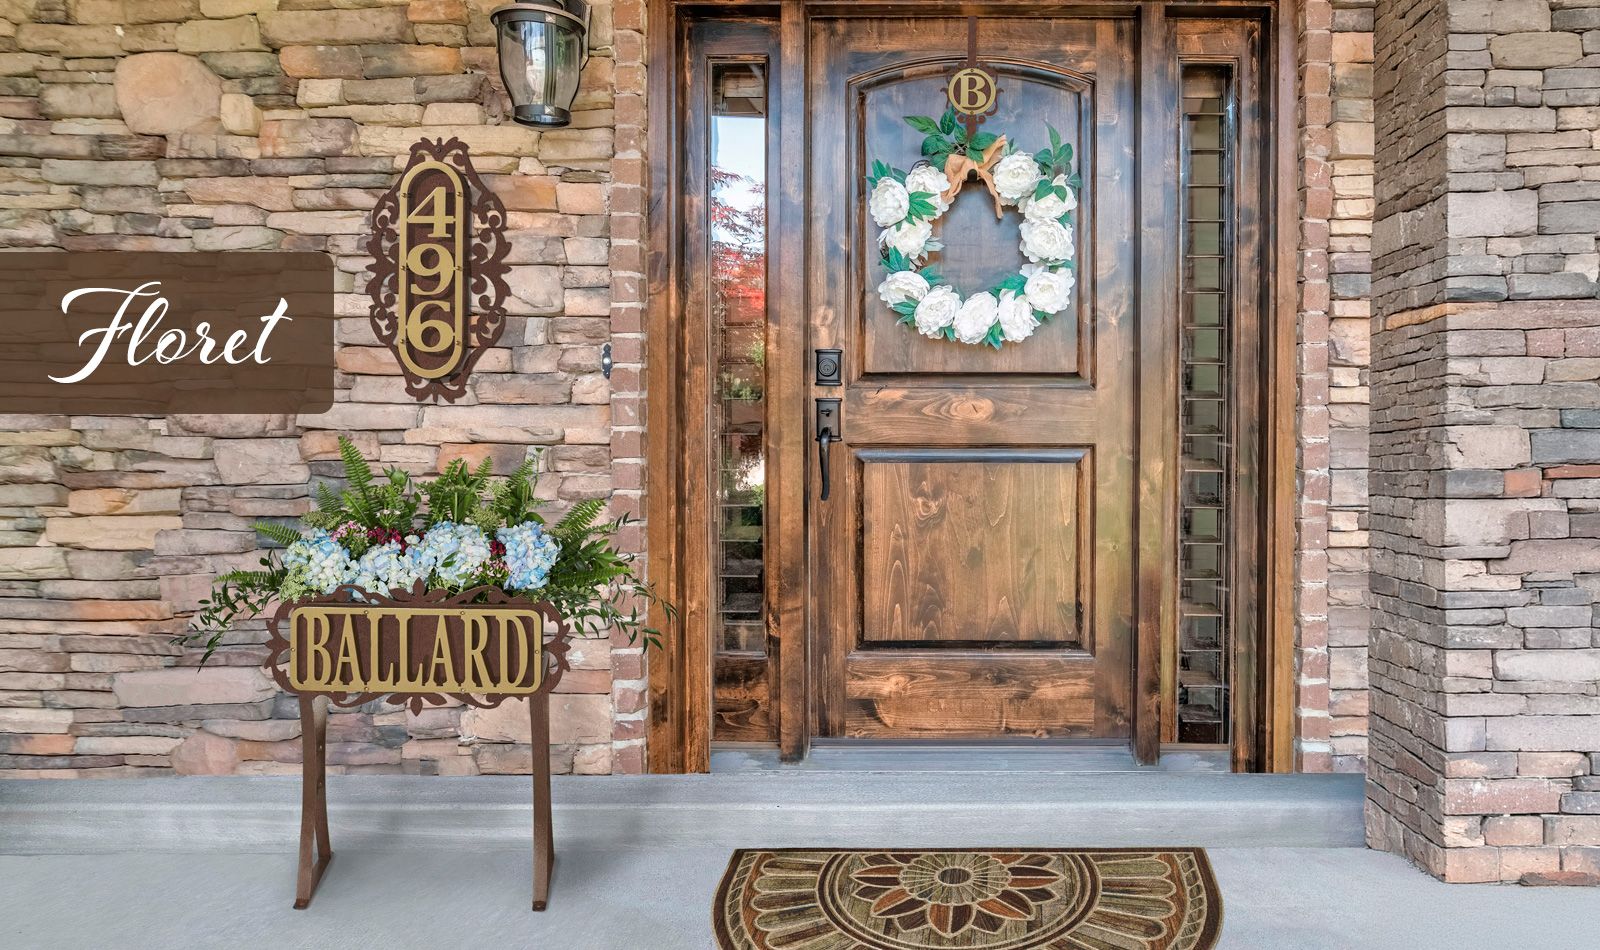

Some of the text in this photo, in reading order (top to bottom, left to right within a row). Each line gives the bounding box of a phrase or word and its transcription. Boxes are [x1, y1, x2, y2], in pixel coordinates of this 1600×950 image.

[960, 74, 987, 107] B
[407, 186, 454, 352] 496
[302, 611, 529, 687] BALLARD
